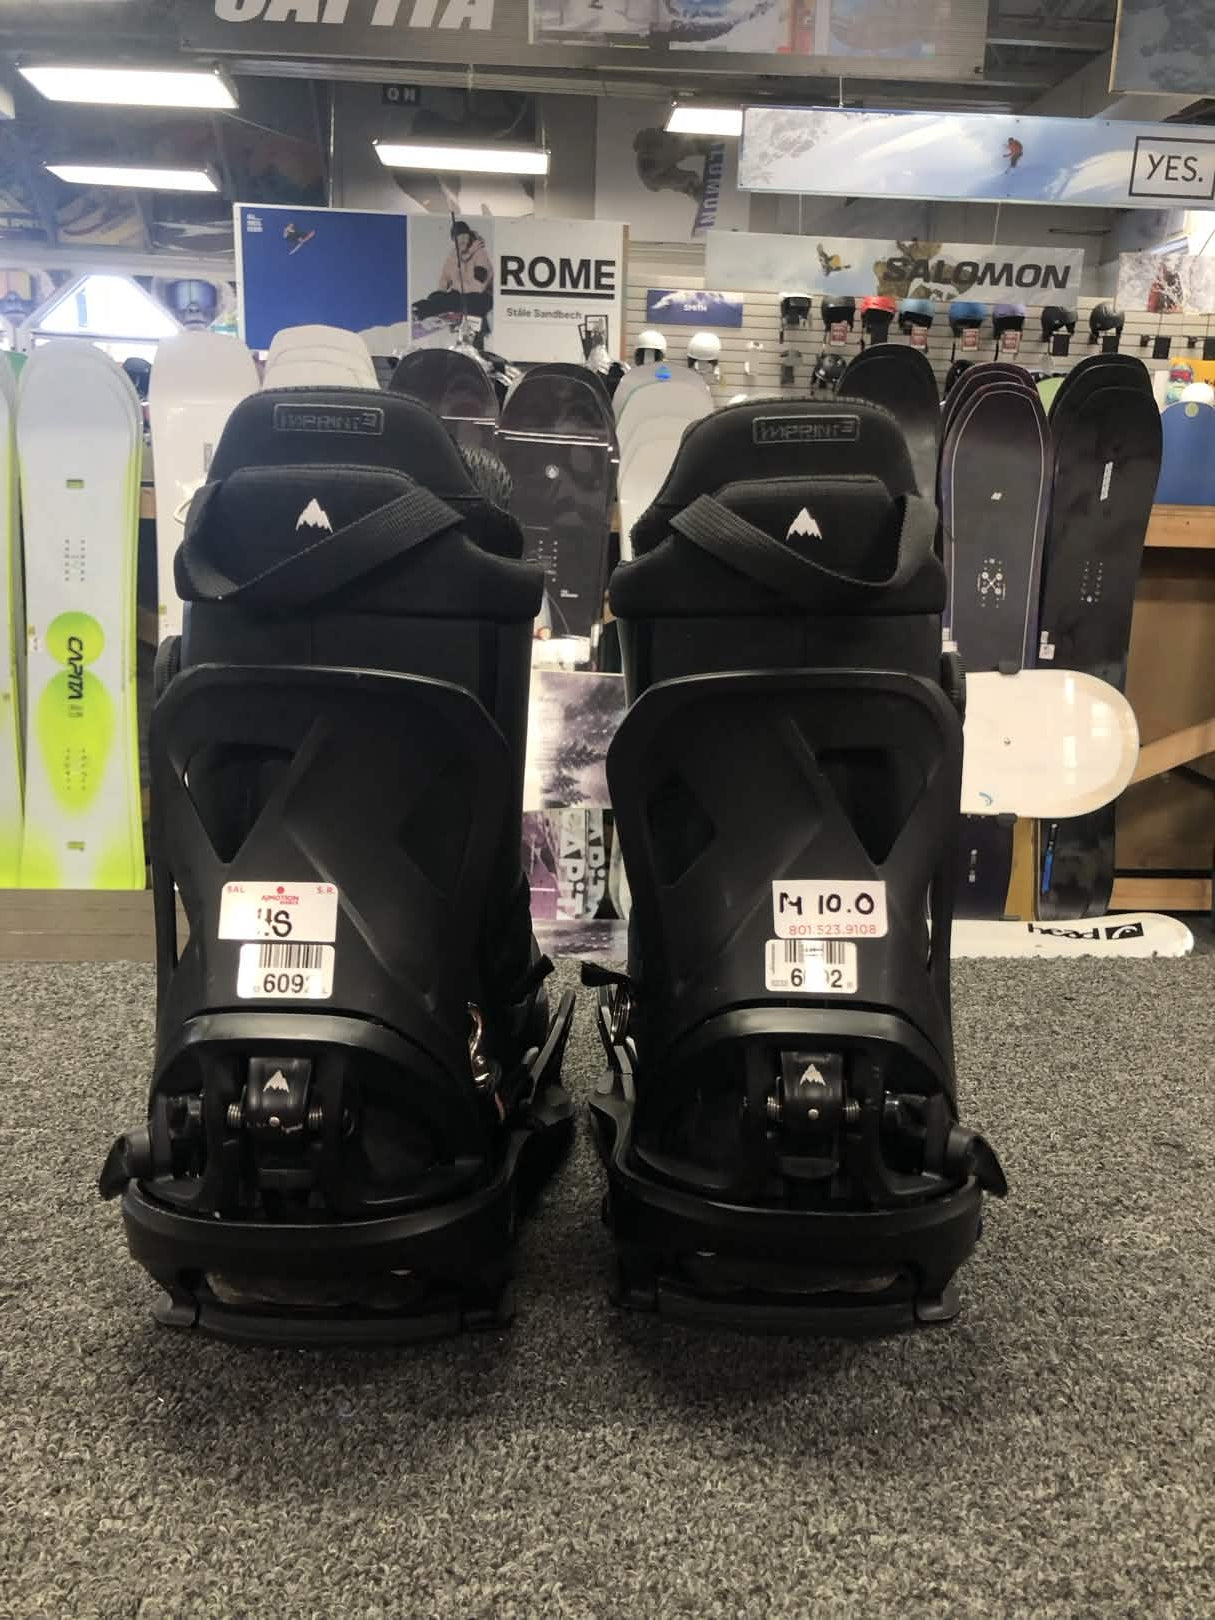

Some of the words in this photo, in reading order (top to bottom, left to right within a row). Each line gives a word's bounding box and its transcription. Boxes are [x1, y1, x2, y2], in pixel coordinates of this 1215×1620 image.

[1147, 153, 1204, 182] YES.
[500, 255, 616, 290] ROME
[883, 256, 1071, 289] SALOMON
[818, 892, 875, 915] 10.0
[789, 924, 877, 935] 801.523.9108
[263, 973, 309, 993] 609
